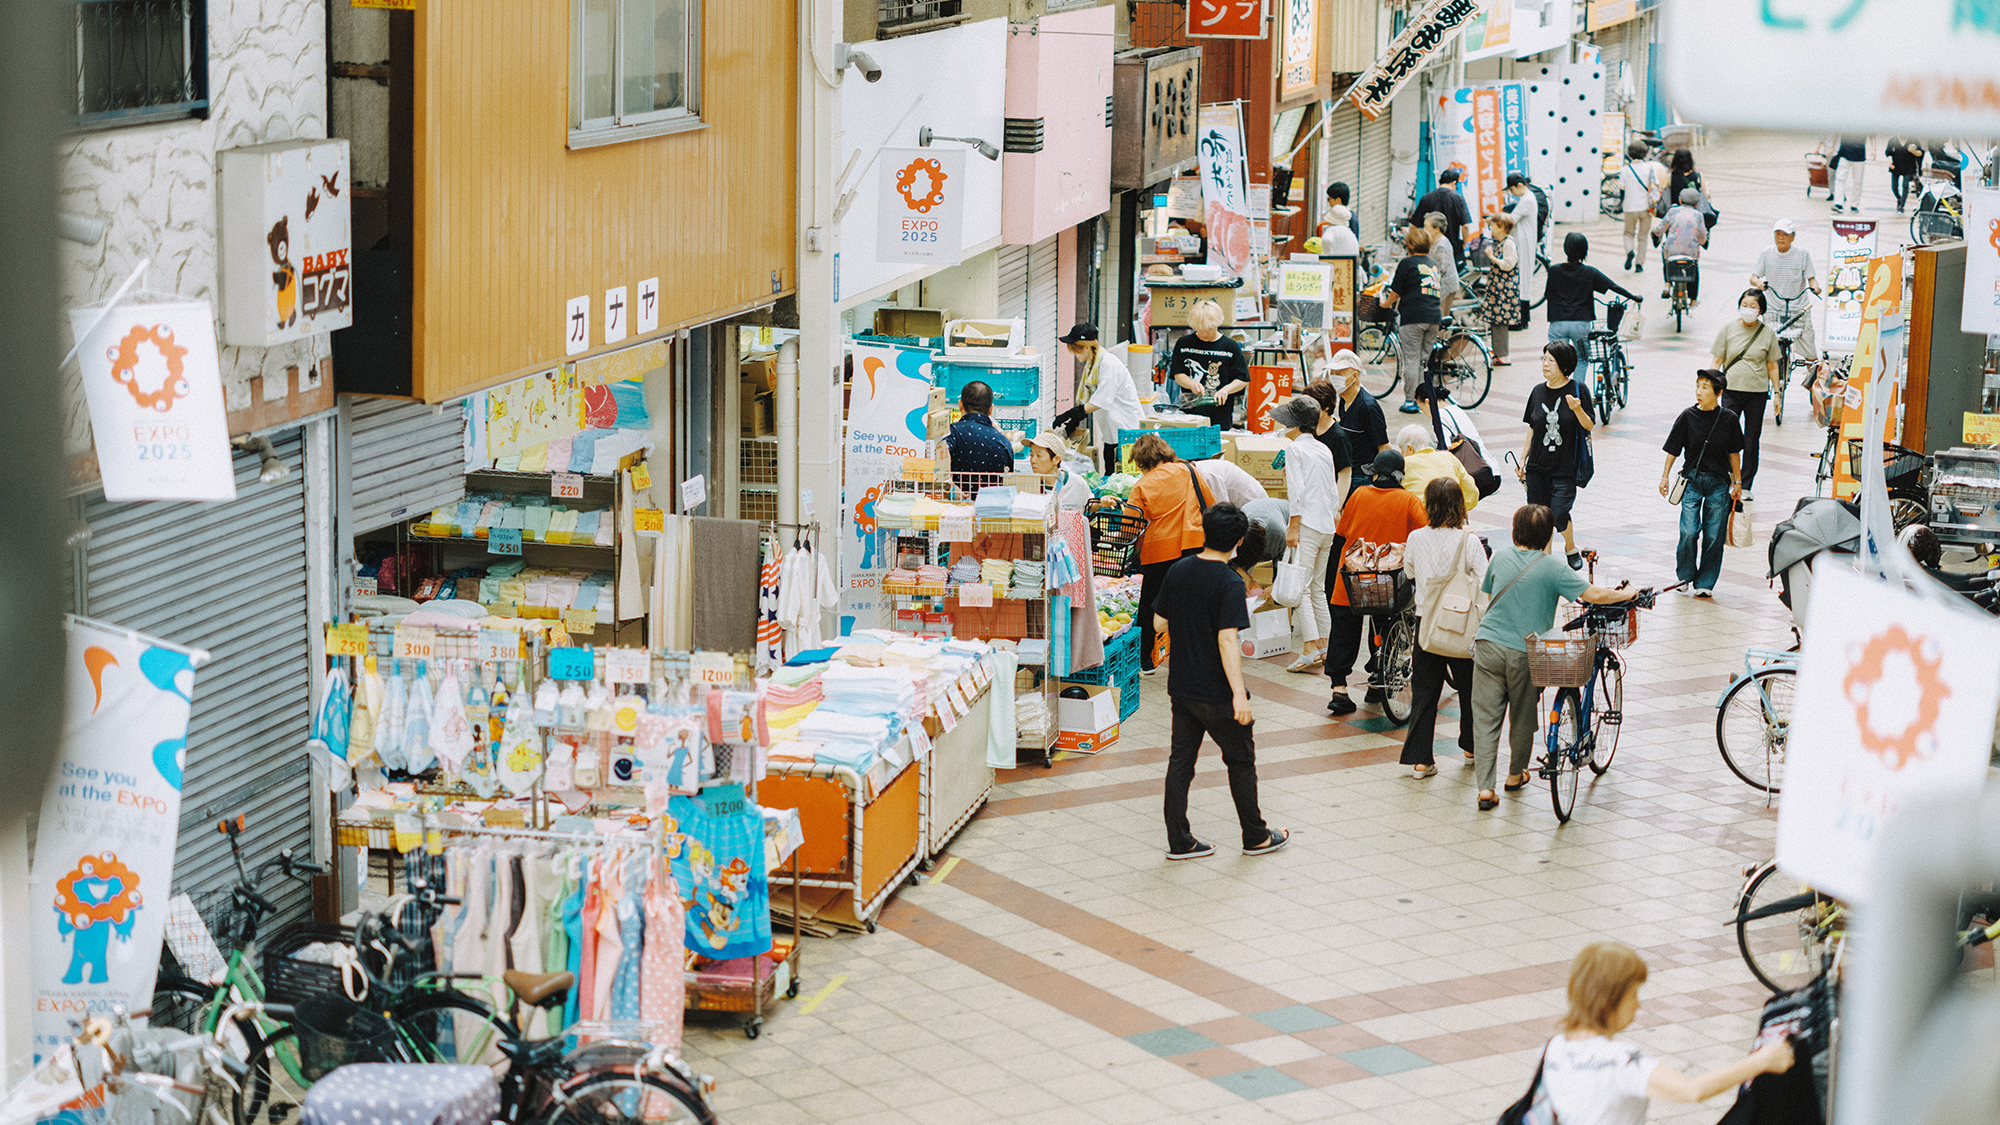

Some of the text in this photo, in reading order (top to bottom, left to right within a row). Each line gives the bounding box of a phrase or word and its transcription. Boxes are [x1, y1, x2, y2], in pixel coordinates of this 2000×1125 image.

[901, 219, 938, 231] EXPO
[901, 230, 937, 242] 2025
[303, 248, 348, 273] BABY
[303, 267, 349, 311] コグマ
[571, 284, 656, 343] カナヤ
[1278, 374, 1290, 387] 活
[133, 426, 190, 442] EXPO
[853, 430, 897, 444] See you
[137, 444, 192, 460] 2025
[852, 444, 917, 458] at the EXPO
[560, 485, 579, 496] 220
[644, 521, 662, 531] 500
[499, 542, 519, 553] 250
[912, 612, 921, 621] 10
[940, 614, 949, 624] 10
[340, 640, 365, 654] 250
[404, 643, 430, 656] 300
[490, 646, 516, 659] 380
[565, 665, 590, 677] 250
[620, 667, 643, 680] 150
[702, 669, 732, 682] 1200
[61, 761, 138, 788] See you
[58, 783, 76, 798] at
[82, 785, 112, 802] the
[117, 789, 168, 815] EXPO
[715, 800, 744, 815] 1200
